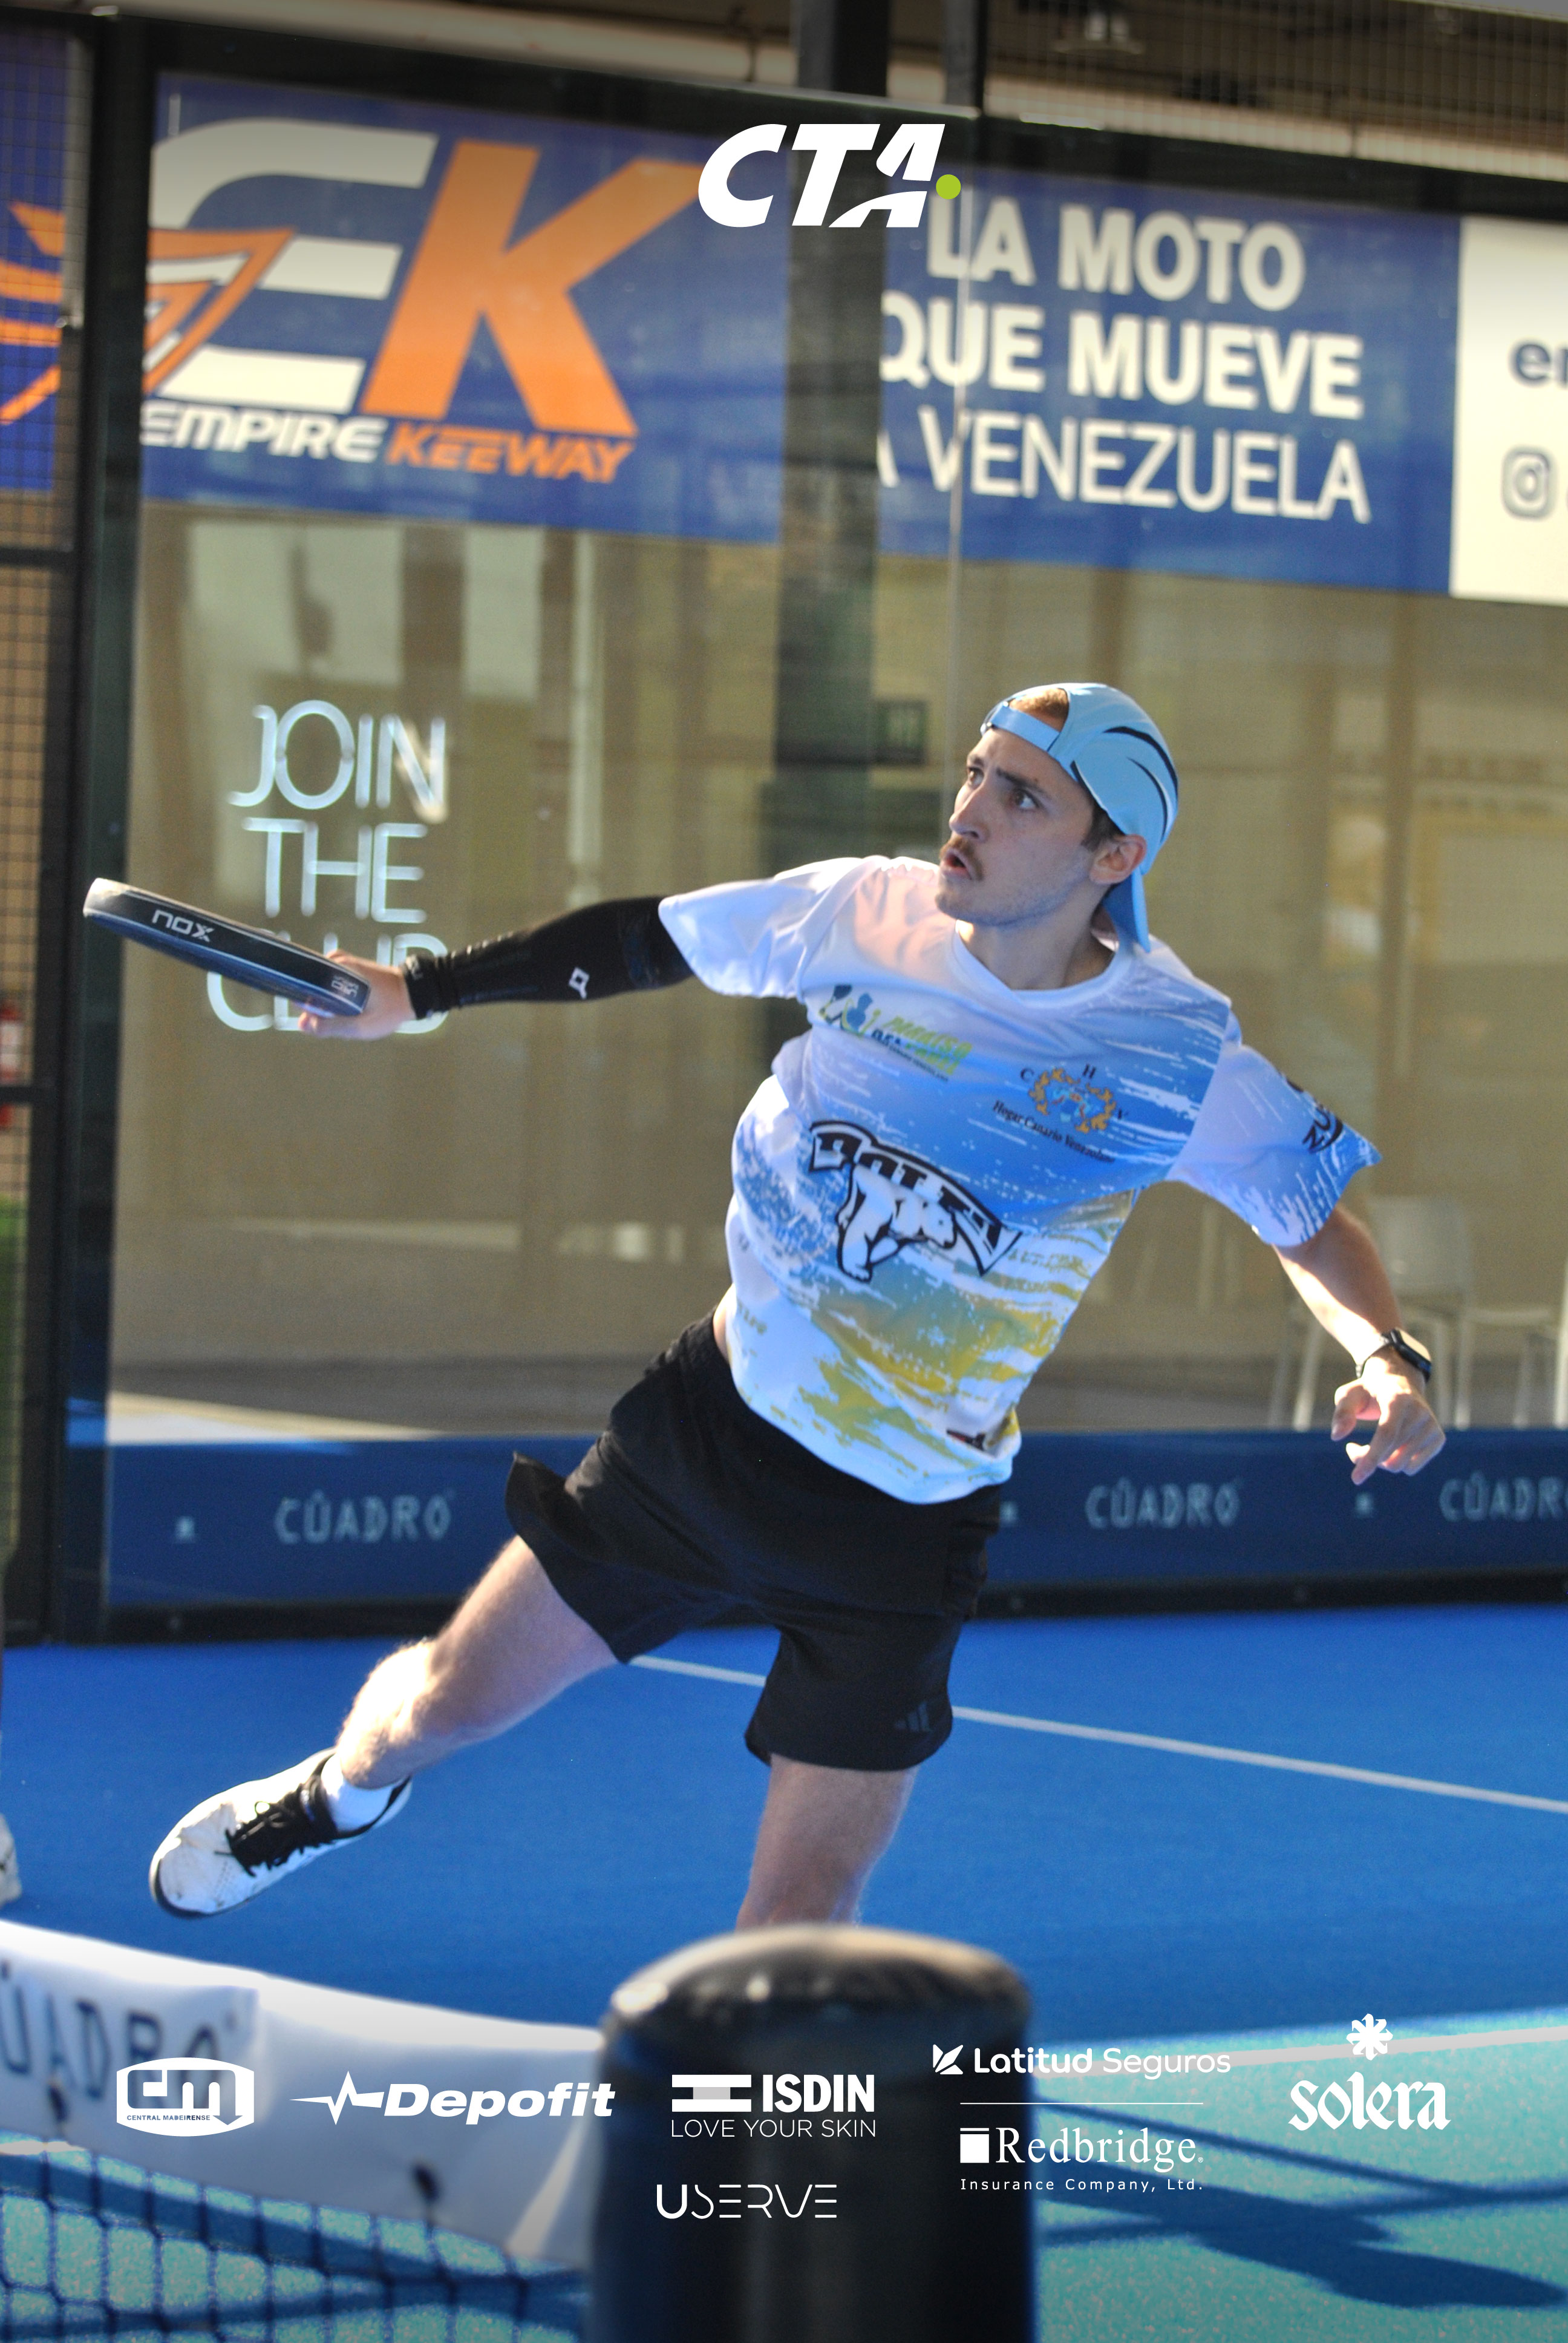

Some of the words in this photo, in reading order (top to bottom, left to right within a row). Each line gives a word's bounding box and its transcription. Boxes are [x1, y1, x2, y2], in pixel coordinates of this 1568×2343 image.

[926, 195, 1035, 287] LA
[1057, 203, 1305, 312] MOTO
[880, 289, 1045, 392] QUE
[1068, 310, 1365, 420] MUEVE
[140, 399, 388, 464] EMPIRE
[384, 421, 635, 483] KEEWAY
[918, 406, 1371, 524] VENEZUELA
[227, 700, 448, 822] JOIN
[242, 818, 428, 923] THE
[992, 1099, 1024, 1123] Hogar
[1024, 1116, 1063, 1142] Canario
